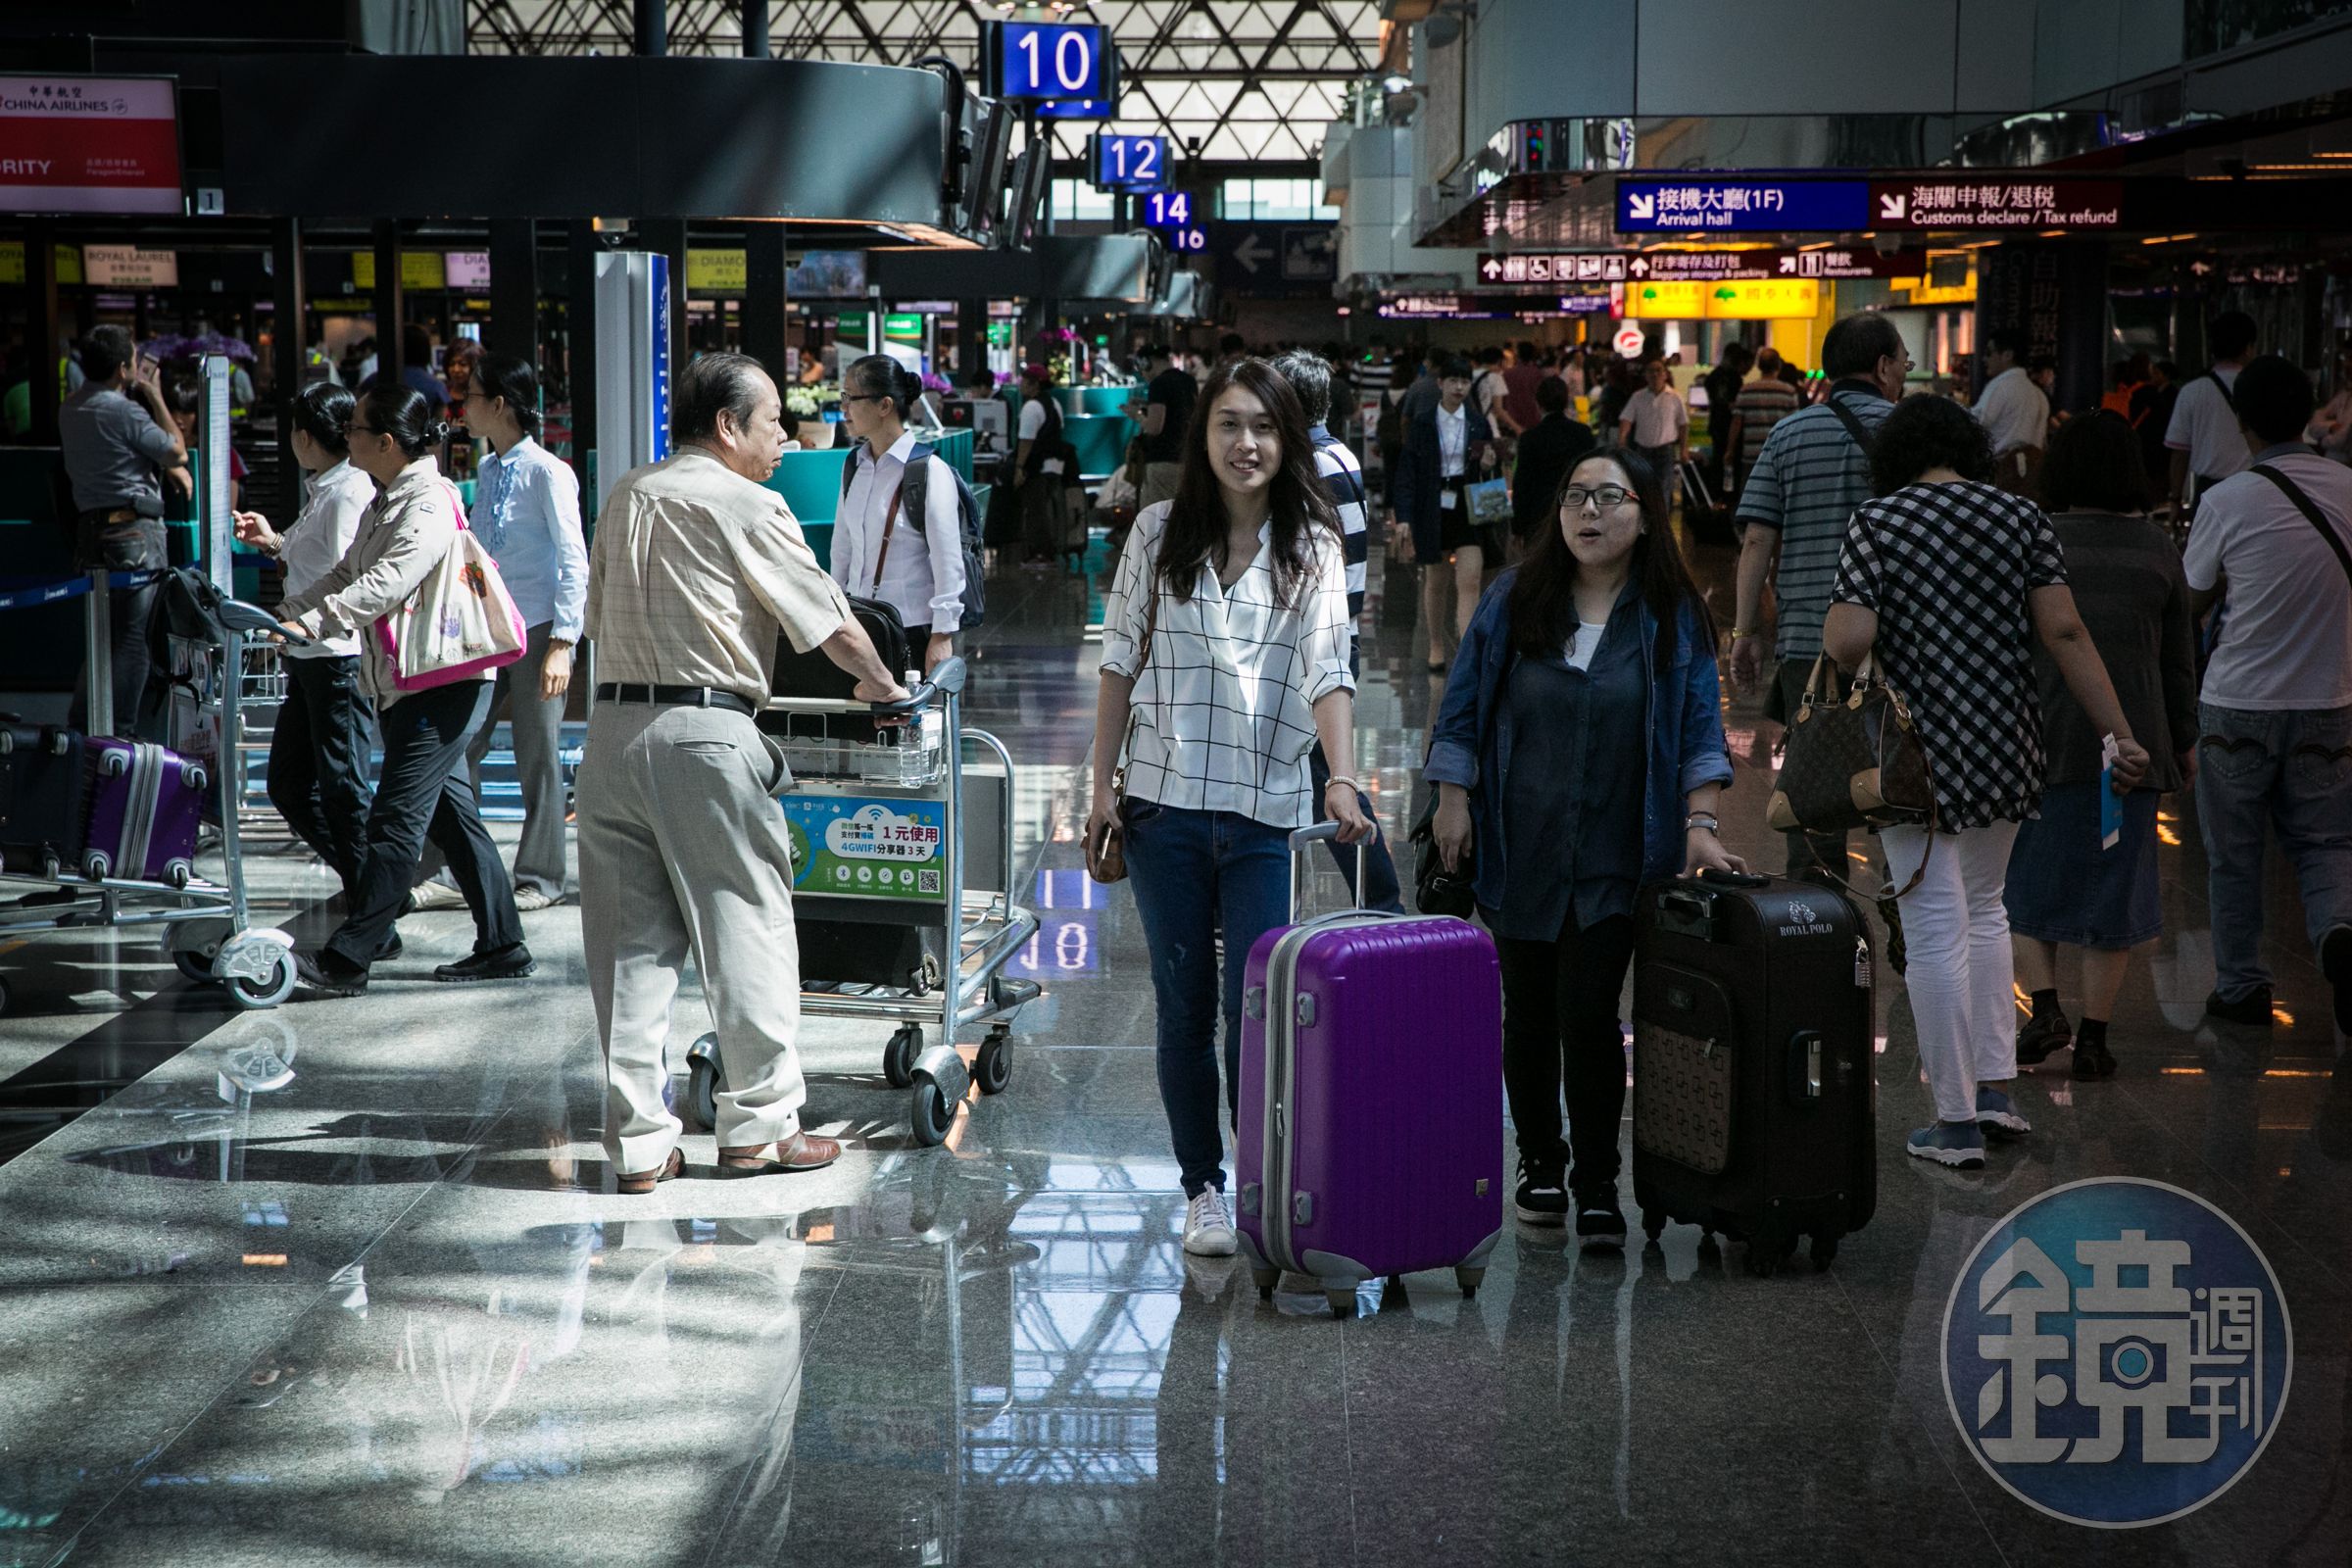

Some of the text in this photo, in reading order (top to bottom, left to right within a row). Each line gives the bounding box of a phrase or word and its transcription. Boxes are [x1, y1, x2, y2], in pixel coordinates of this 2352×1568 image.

[1018, 30, 1091, 91] 10
[29, 85, 82, 98] 中華航空
[5, 100, 108, 112] CHINA AIRLINES
[1110, 138, 1157, 178] 12
[0, 159, 51, 175] RITY
[207, 193, 214, 209] 1
[1656, 187, 1785, 212] 接機大廳(1F)
[1151, 192, 1189, 224] 14
[1911, 210, 1974, 224] Customs
[1977, 209, 2031, 224] declare
[2043, 210, 2067, 224] Tax
[2070, 207, 2118, 224] refund
[1656, 211, 1734, 226] Arrival hall
[1178, 228, 1205, 249] 16
[87, 250, 172, 264] ROYAL LAUREL
[1649, 270, 1690, 281] Baggage
[1690, 270, 1724, 280] storage
[1733, 269, 1769, 280] packing
[1823, 267, 1874, 277] Restaurants
[895, 826, 938, 843] 元使用
[841, 843, 925, 857] 4GWIFI分享器 3 天
[1780, 923, 1833, 937] ROYAL POLO
